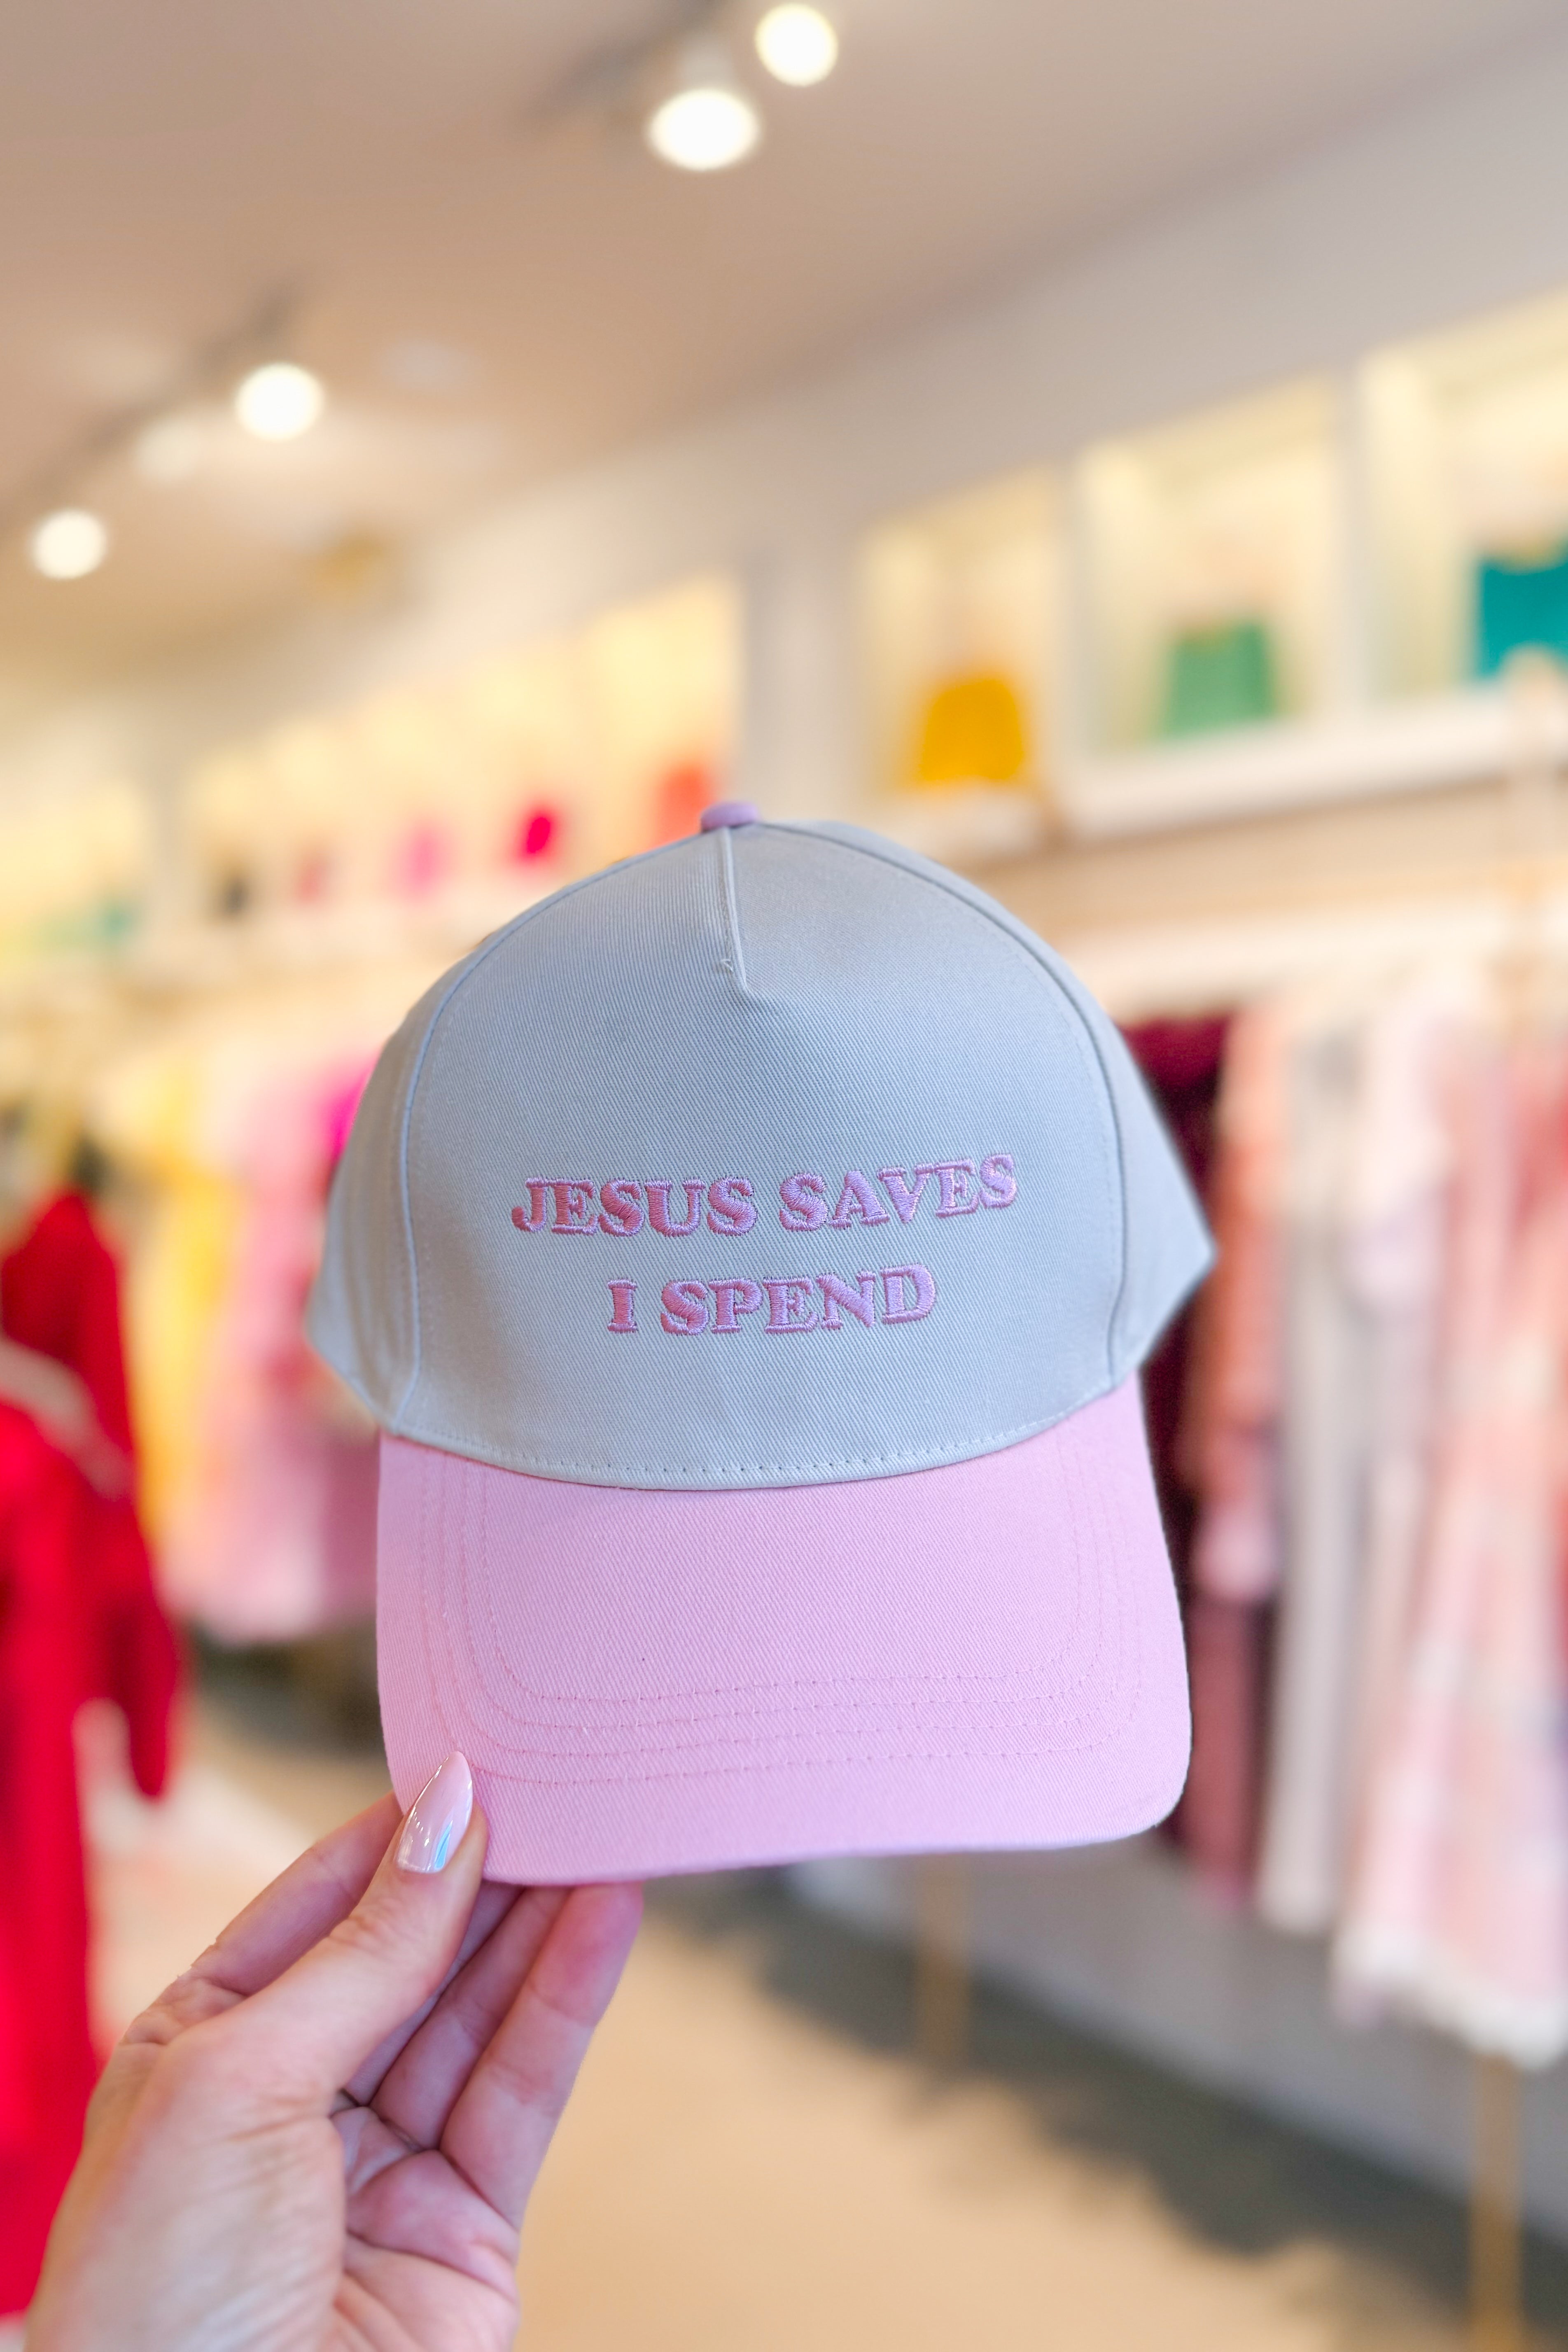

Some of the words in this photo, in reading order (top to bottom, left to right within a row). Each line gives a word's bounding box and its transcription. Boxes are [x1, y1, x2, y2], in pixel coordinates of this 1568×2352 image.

[511, 1176, 757, 1237] JESUS
[779, 1153, 1018, 1232] SAVES
[607, 1278, 638, 1334] I
[660, 1263, 936, 1336] SPEND
